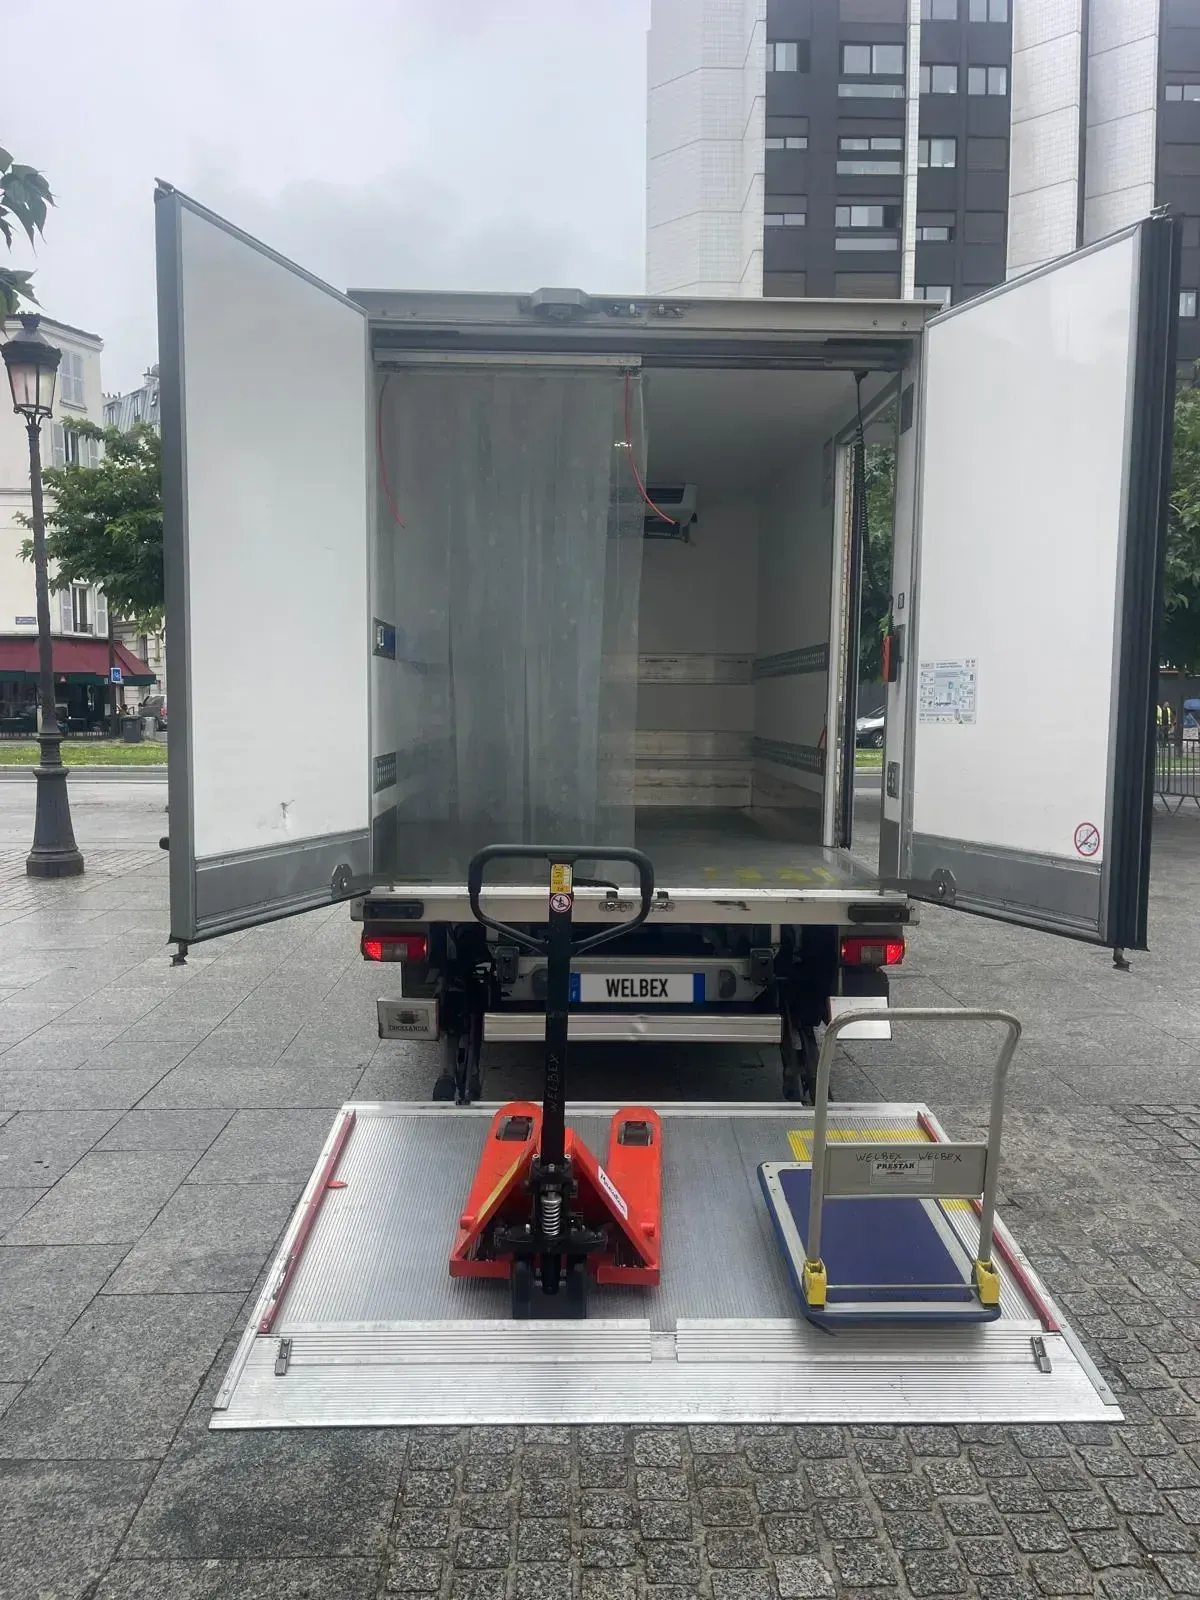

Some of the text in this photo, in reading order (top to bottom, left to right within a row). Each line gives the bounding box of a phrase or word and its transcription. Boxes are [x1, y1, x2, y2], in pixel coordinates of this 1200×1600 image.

[606, 978, 669, 998] WELBEX
[547, 1053, 560, 1112] WELBEX
[855, 1152, 962, 1163] WELBEX WELBEX
[876, 1162, 915, 1170] PRESTAR
